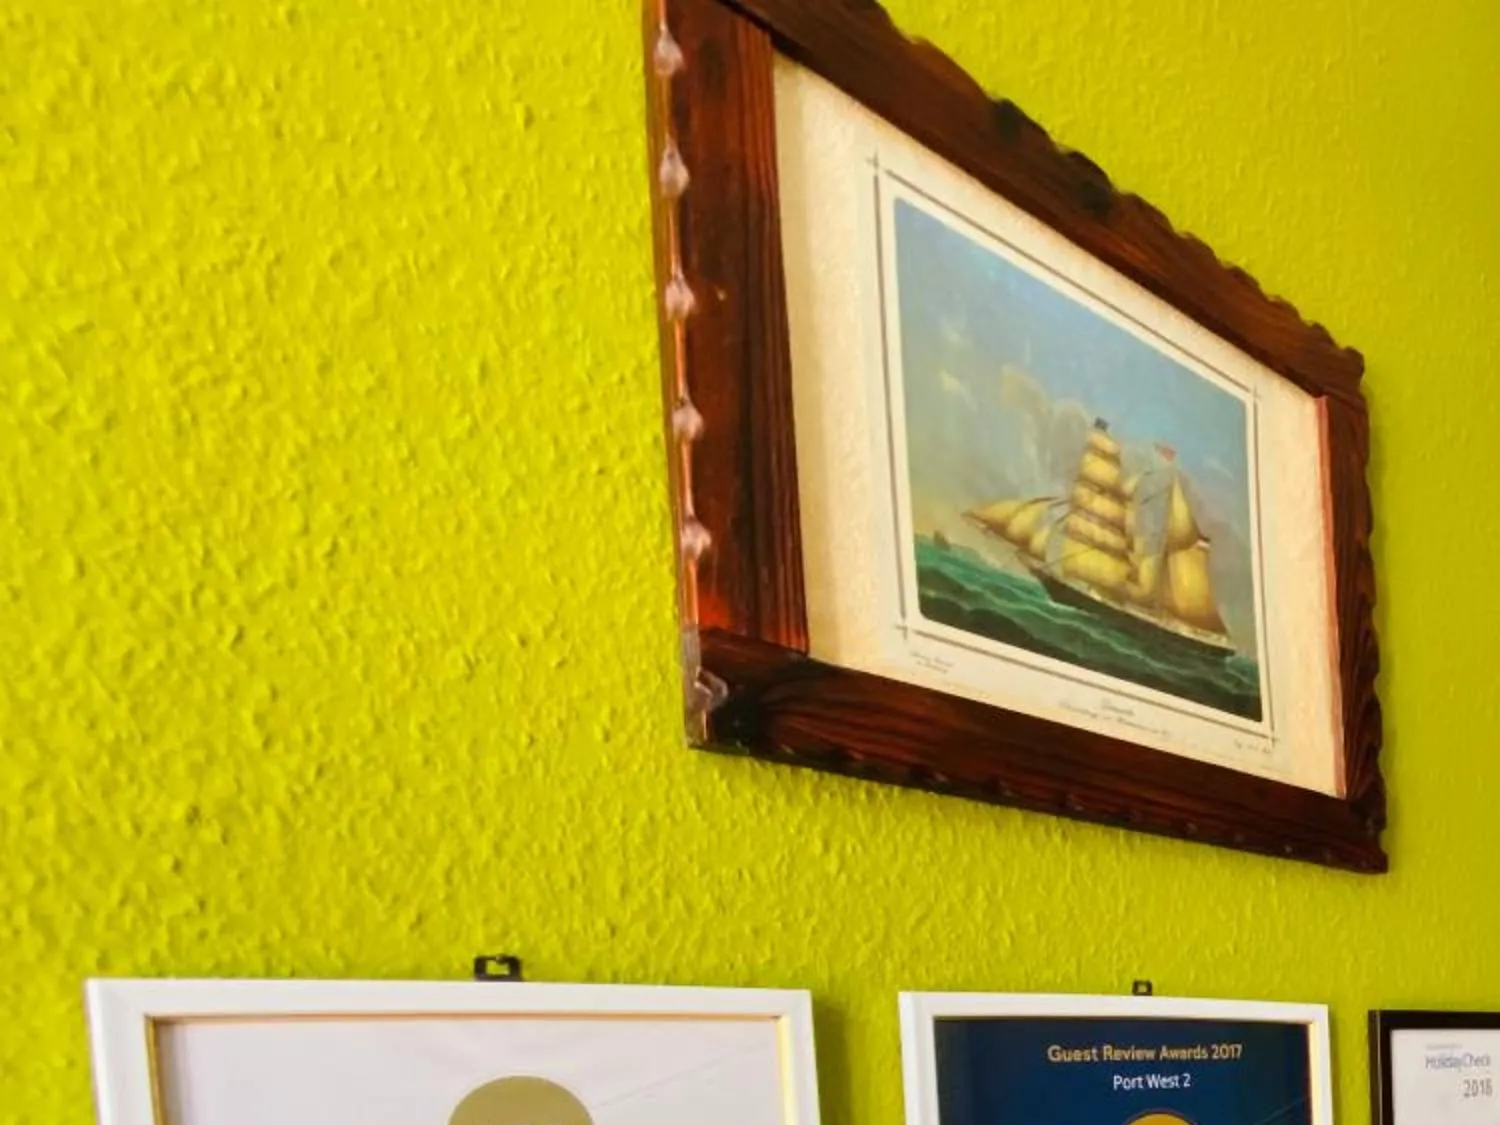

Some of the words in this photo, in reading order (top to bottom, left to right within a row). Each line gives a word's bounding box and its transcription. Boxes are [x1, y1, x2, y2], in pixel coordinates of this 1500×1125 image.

[1047, 1044, 1099, 1063] Guest
[1102, 1044, 1156, 1061] Review
[1159, 1044, 1209, 1061] Awards
[1211, 1043, 1243, 1060] 2017
[1113, 1075, 1144, 1091] Port
[1146, 1073, 1181, 1090] West
[1183, 1073, 1191, 1088] 2
